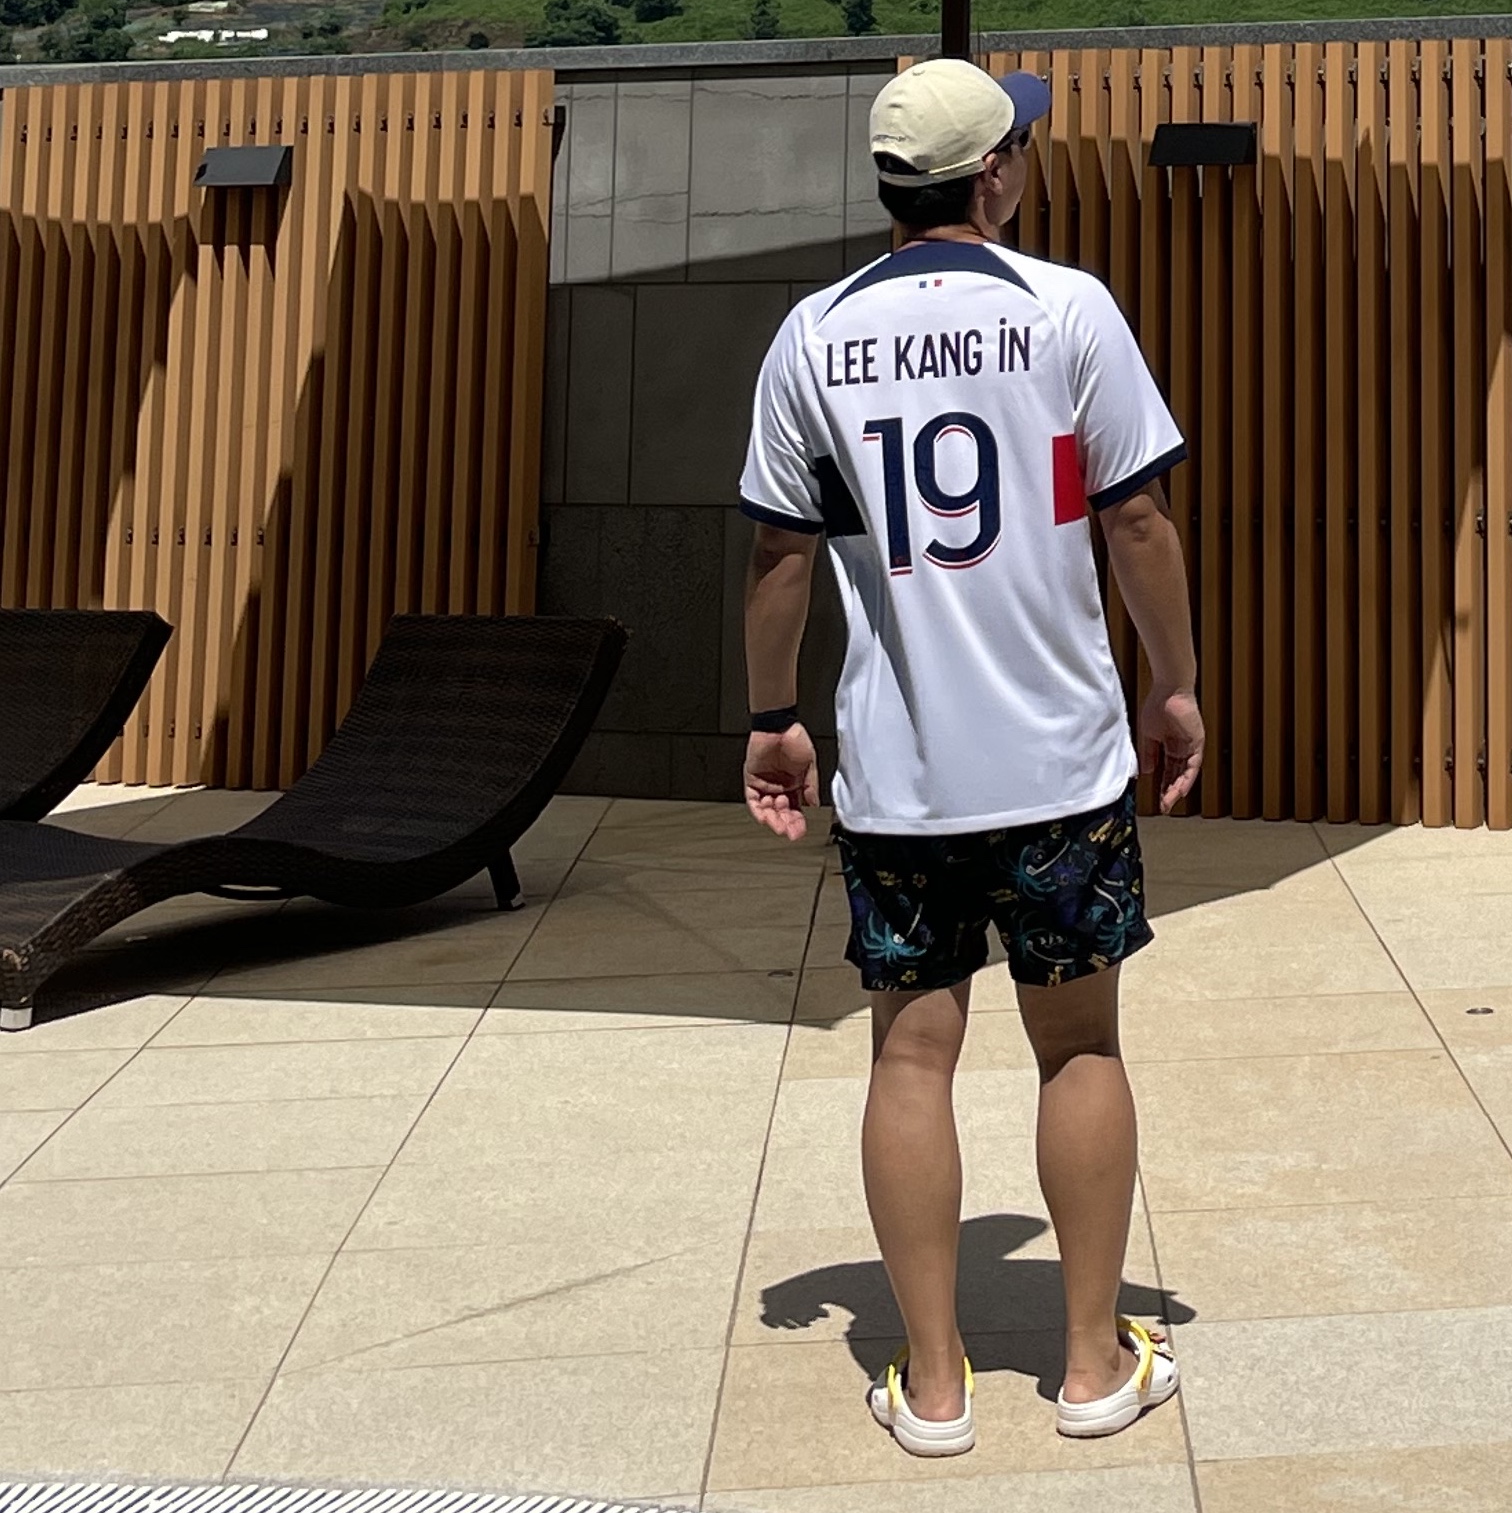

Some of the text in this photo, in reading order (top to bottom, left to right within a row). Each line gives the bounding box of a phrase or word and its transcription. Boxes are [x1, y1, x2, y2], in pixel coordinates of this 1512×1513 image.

[827, 338, 879, 387] LEE
[895, 329, 982, 381] KANG
[862, 411, 1001, 576] 19
